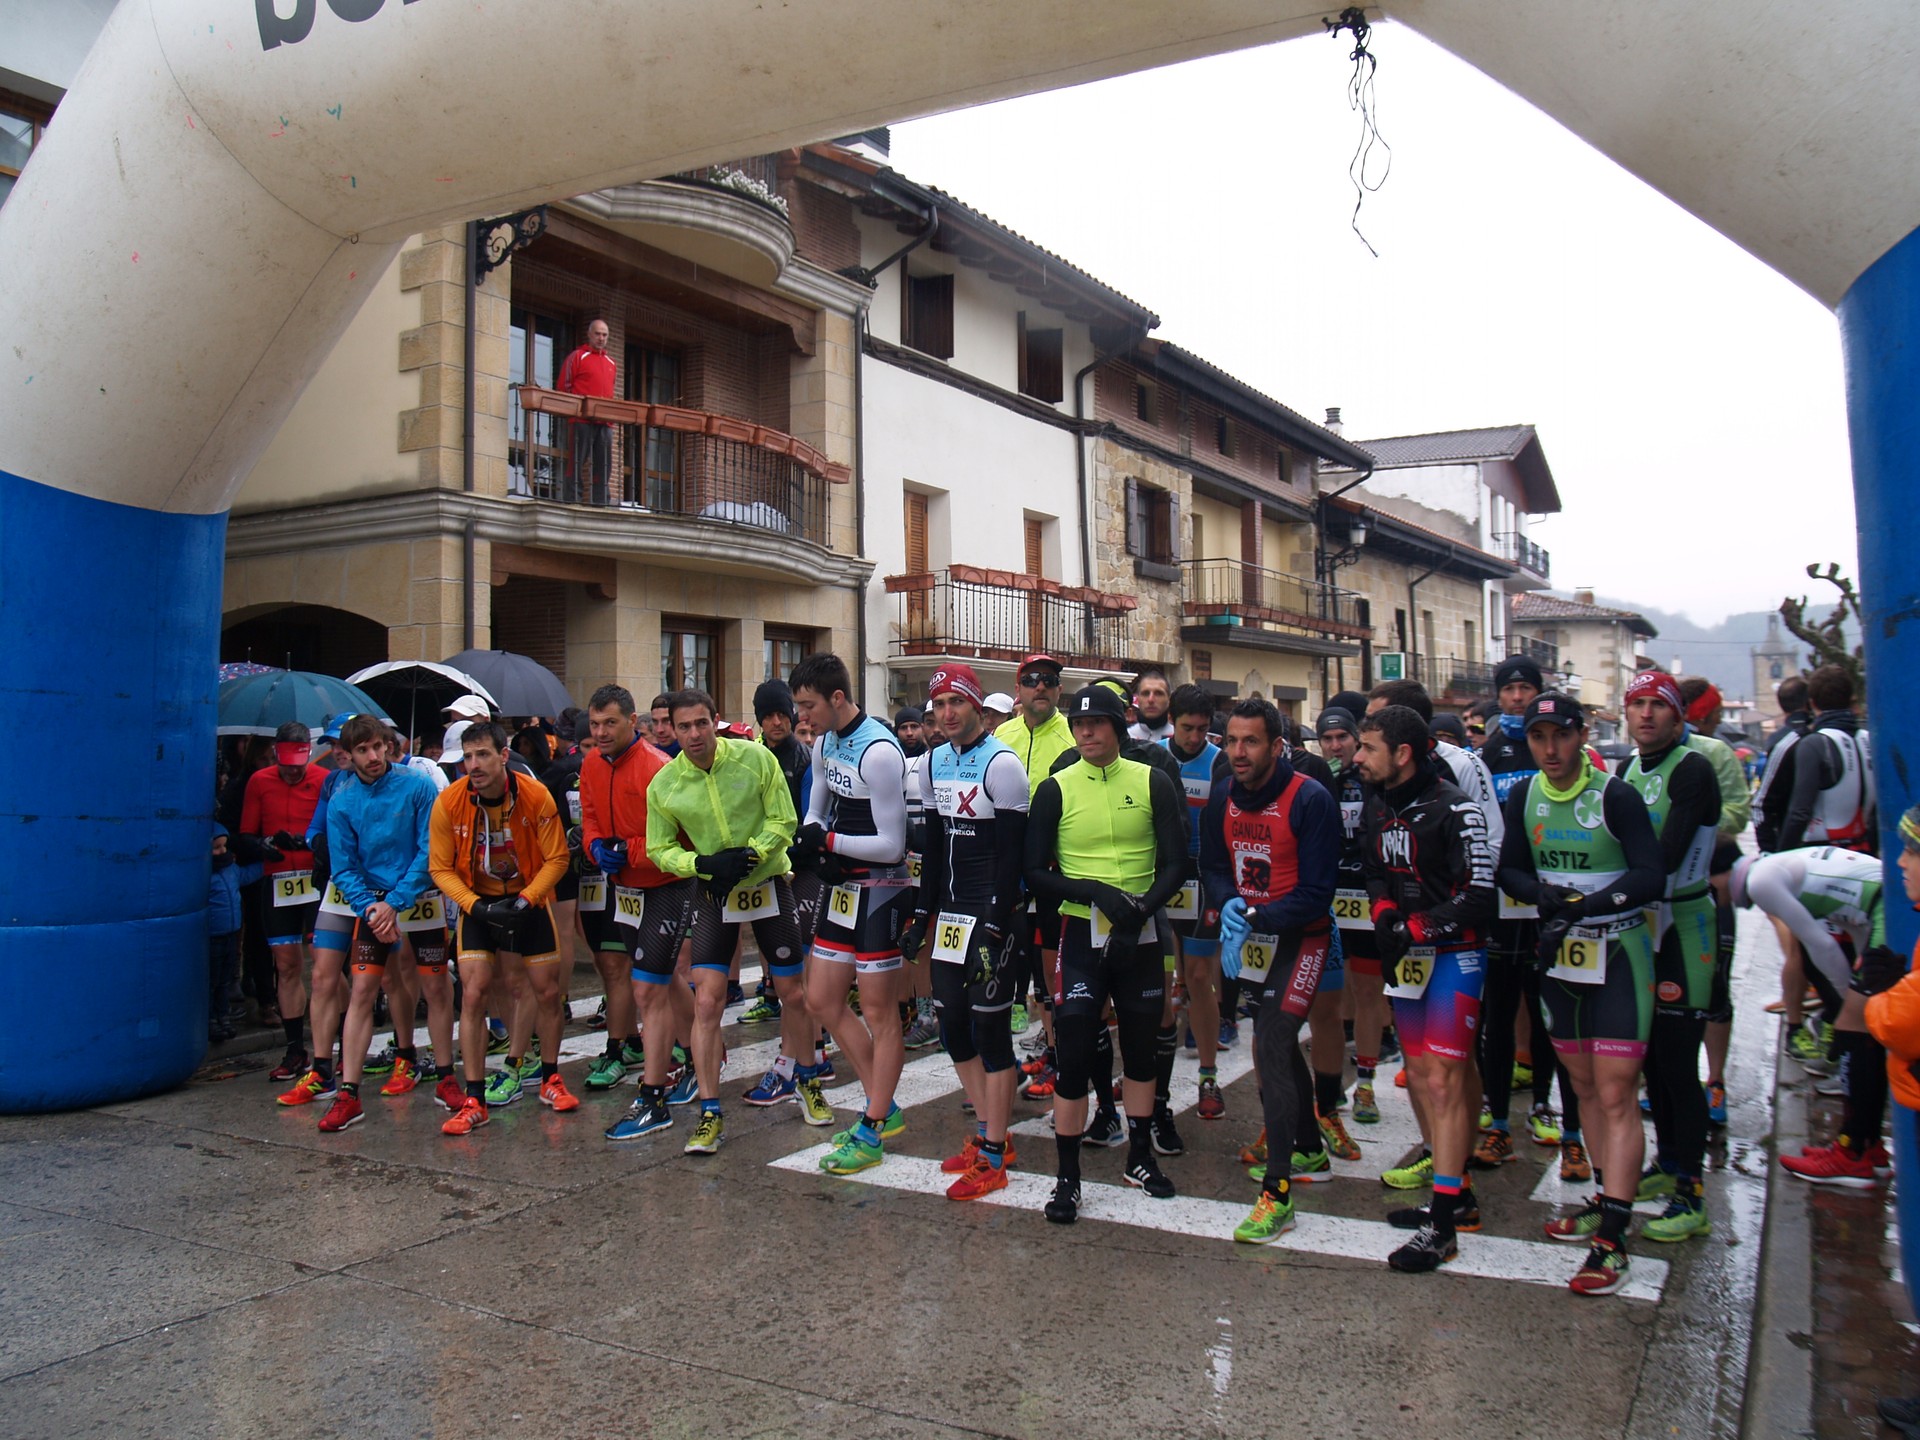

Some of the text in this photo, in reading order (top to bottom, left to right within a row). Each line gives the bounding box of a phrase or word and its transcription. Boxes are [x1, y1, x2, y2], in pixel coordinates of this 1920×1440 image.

[838, 753, 855, 763] CDR
[960, 771, 978, 779] CDR
[1232, 821, 1272, 841] GANUZA
[1545, 829, 1593, 842] SALTOKI
[1232, 841, 1271, 853] CICLOS
[1540, 850, 1592, 869] ASTIZ
[284, 879, 305, 897] 91
[583, 885, 596, 902] 77
[619, 896, 641, 917] 103
[737, 890, 762, 911] 86
[835, 891, 848, 914] 76
[1336, 899, 1362, 918] 28
[408, 901, 434, 921] 26
[943, 926, 961, 949] 56
[1246, 944, 1265, 969] 93
[1293, 955, 1313, 990] CICLOS
[1305, 948, 1325, 995] LIZARRA
[1402, 960, 1424, 985] 65
